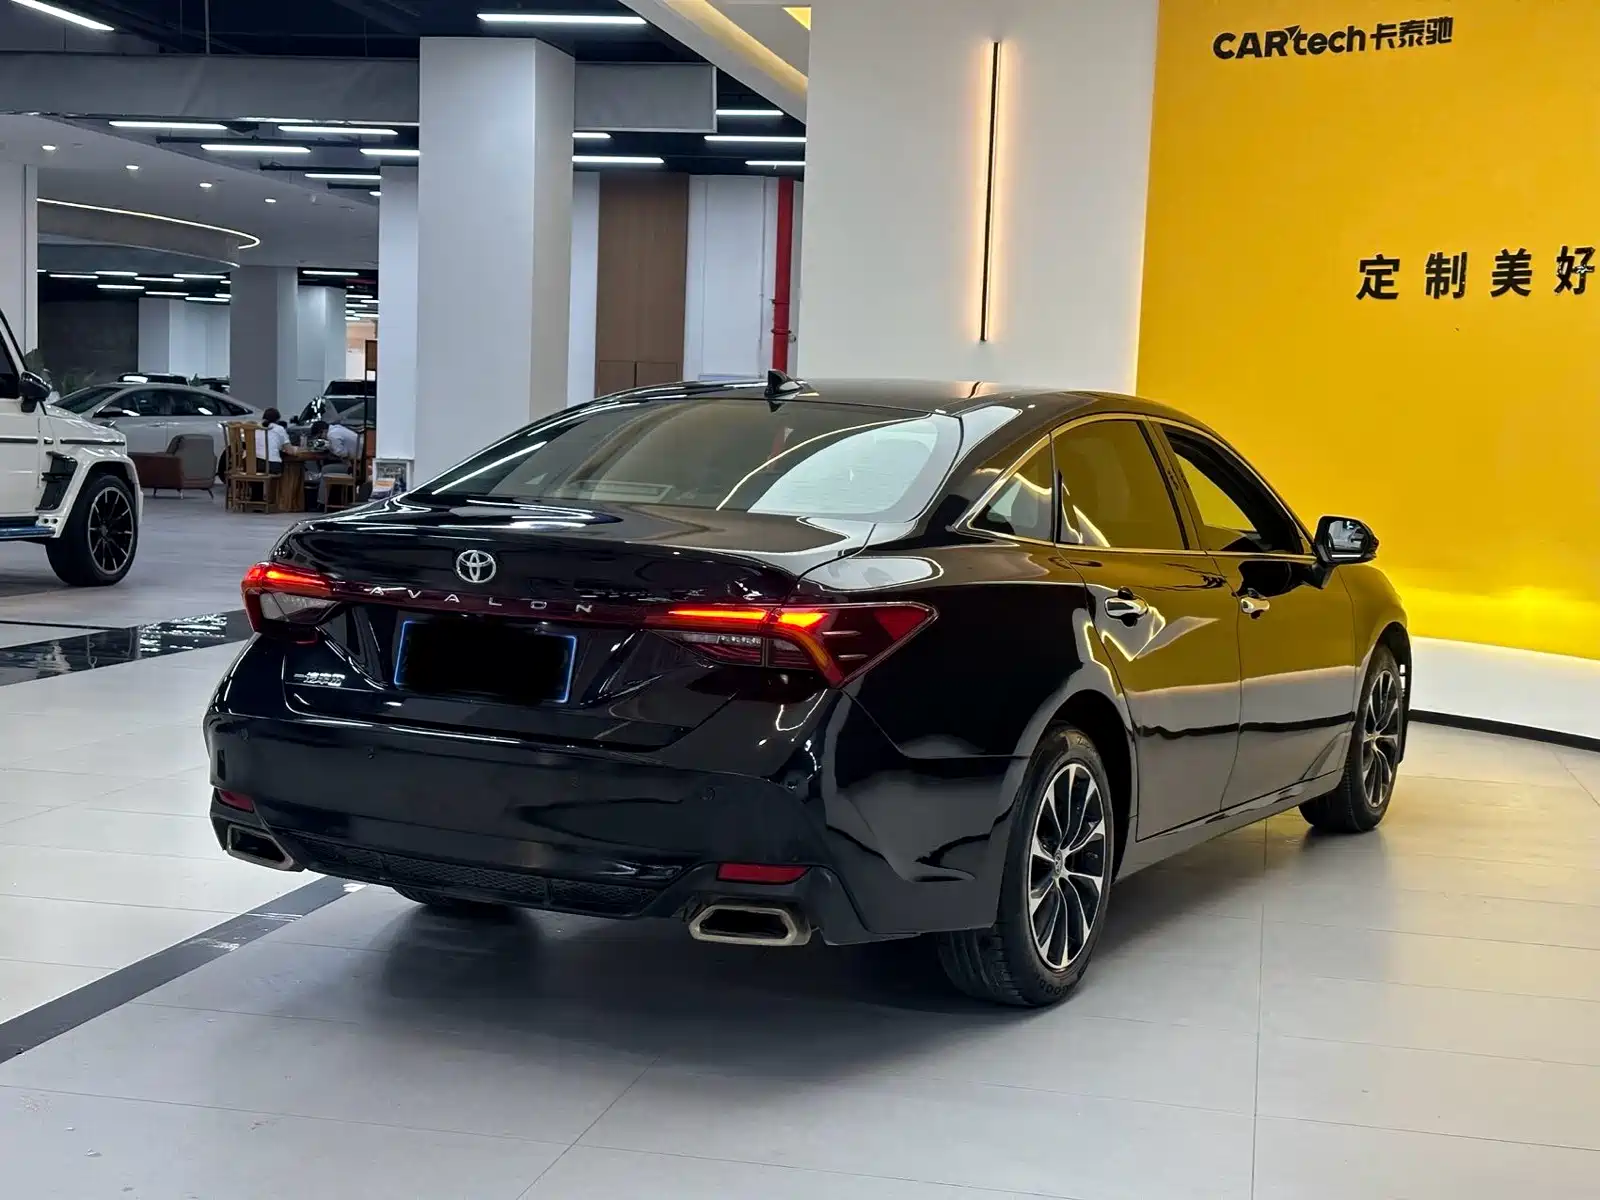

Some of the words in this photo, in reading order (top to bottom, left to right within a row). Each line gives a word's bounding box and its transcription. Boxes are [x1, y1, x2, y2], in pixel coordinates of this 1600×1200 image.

[1213, 25, 1365, 60] CARtech
[1370, 16, 1453, 51] 卡泰驰
[1356, 245, 1596, 301] 定制美好
[367, 586, 593, 614] AVALON
